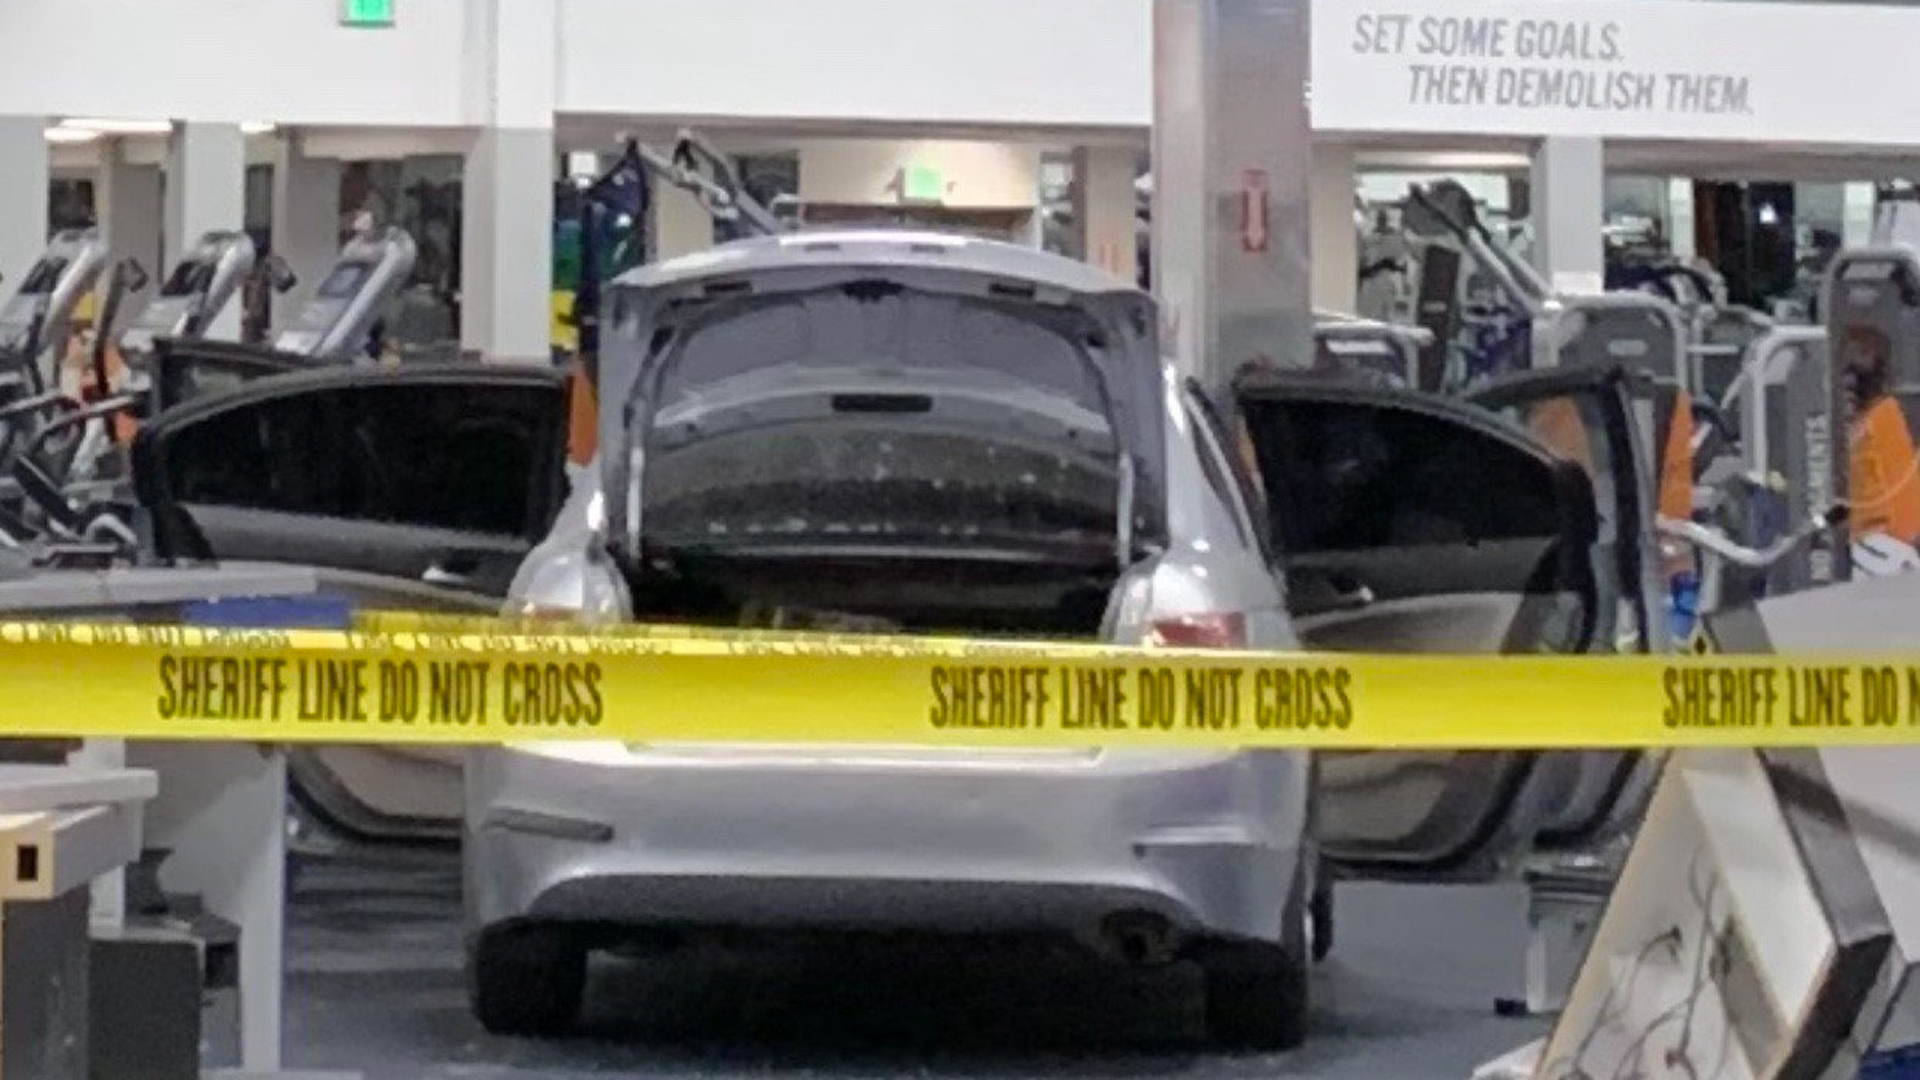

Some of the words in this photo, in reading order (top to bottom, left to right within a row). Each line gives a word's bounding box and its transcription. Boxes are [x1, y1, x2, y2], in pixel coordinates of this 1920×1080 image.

[1352, 14, 1411, 54] SET
[1416, 16, 1509, 58] SOME
[1514, 20, 1624, 62] GOALS.
[1409, 65, 1489, 105] THEN
[1495, 68, 1656, 111] DEMOLISH
[1665, 74, 1755, 114] THEM.
[158, 655, 287, 720] SHERIFF
[298, 658, 367, 722] LINE
[378, 659, 419, 723] DO
[429, 660, 490, 725] NOT
[503, 661, 603, 726] CROSS
[930, 665, 1050, 728] SHERIFF
[1060, 666, 1127, 729] LINE
[1138, 667, 1175, 730] DO
[1185, 667, 1244, 730] NOT
[1255, 667, 1352, 730] CROSS
[1663, 666, 1777, 728] SHERIFF
[1787, 667, 1851, 727] LINE
[1861, 666, 1898, 727] DO
